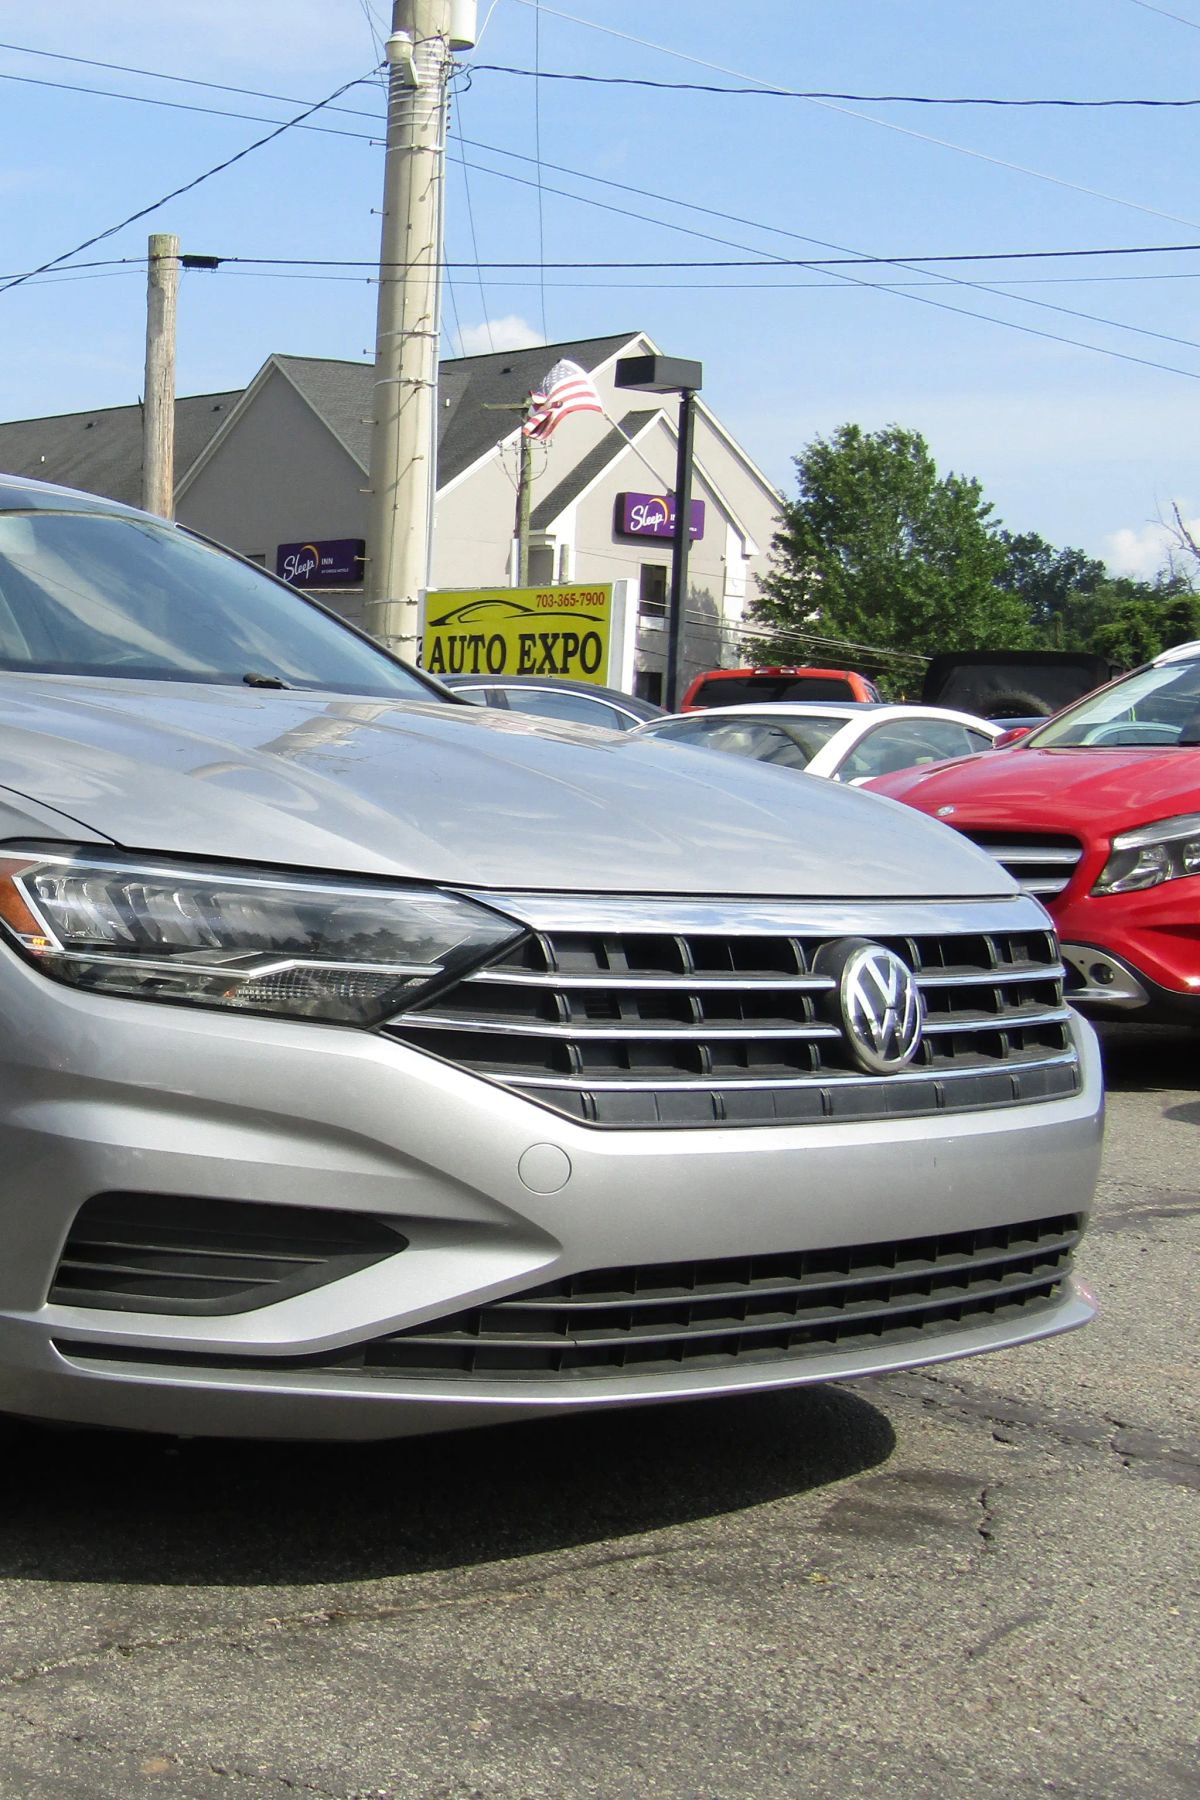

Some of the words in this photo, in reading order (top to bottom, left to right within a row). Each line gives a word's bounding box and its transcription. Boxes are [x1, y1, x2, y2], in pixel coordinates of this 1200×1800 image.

[630, 504, 665, 532] Sleep
[283, 553, 315, 581] Sleep
[535, 591, 605, 608] 703-365-7900
[427, 633, 507, 675] AUTO
[516, 630, 603, 675] EXPO
